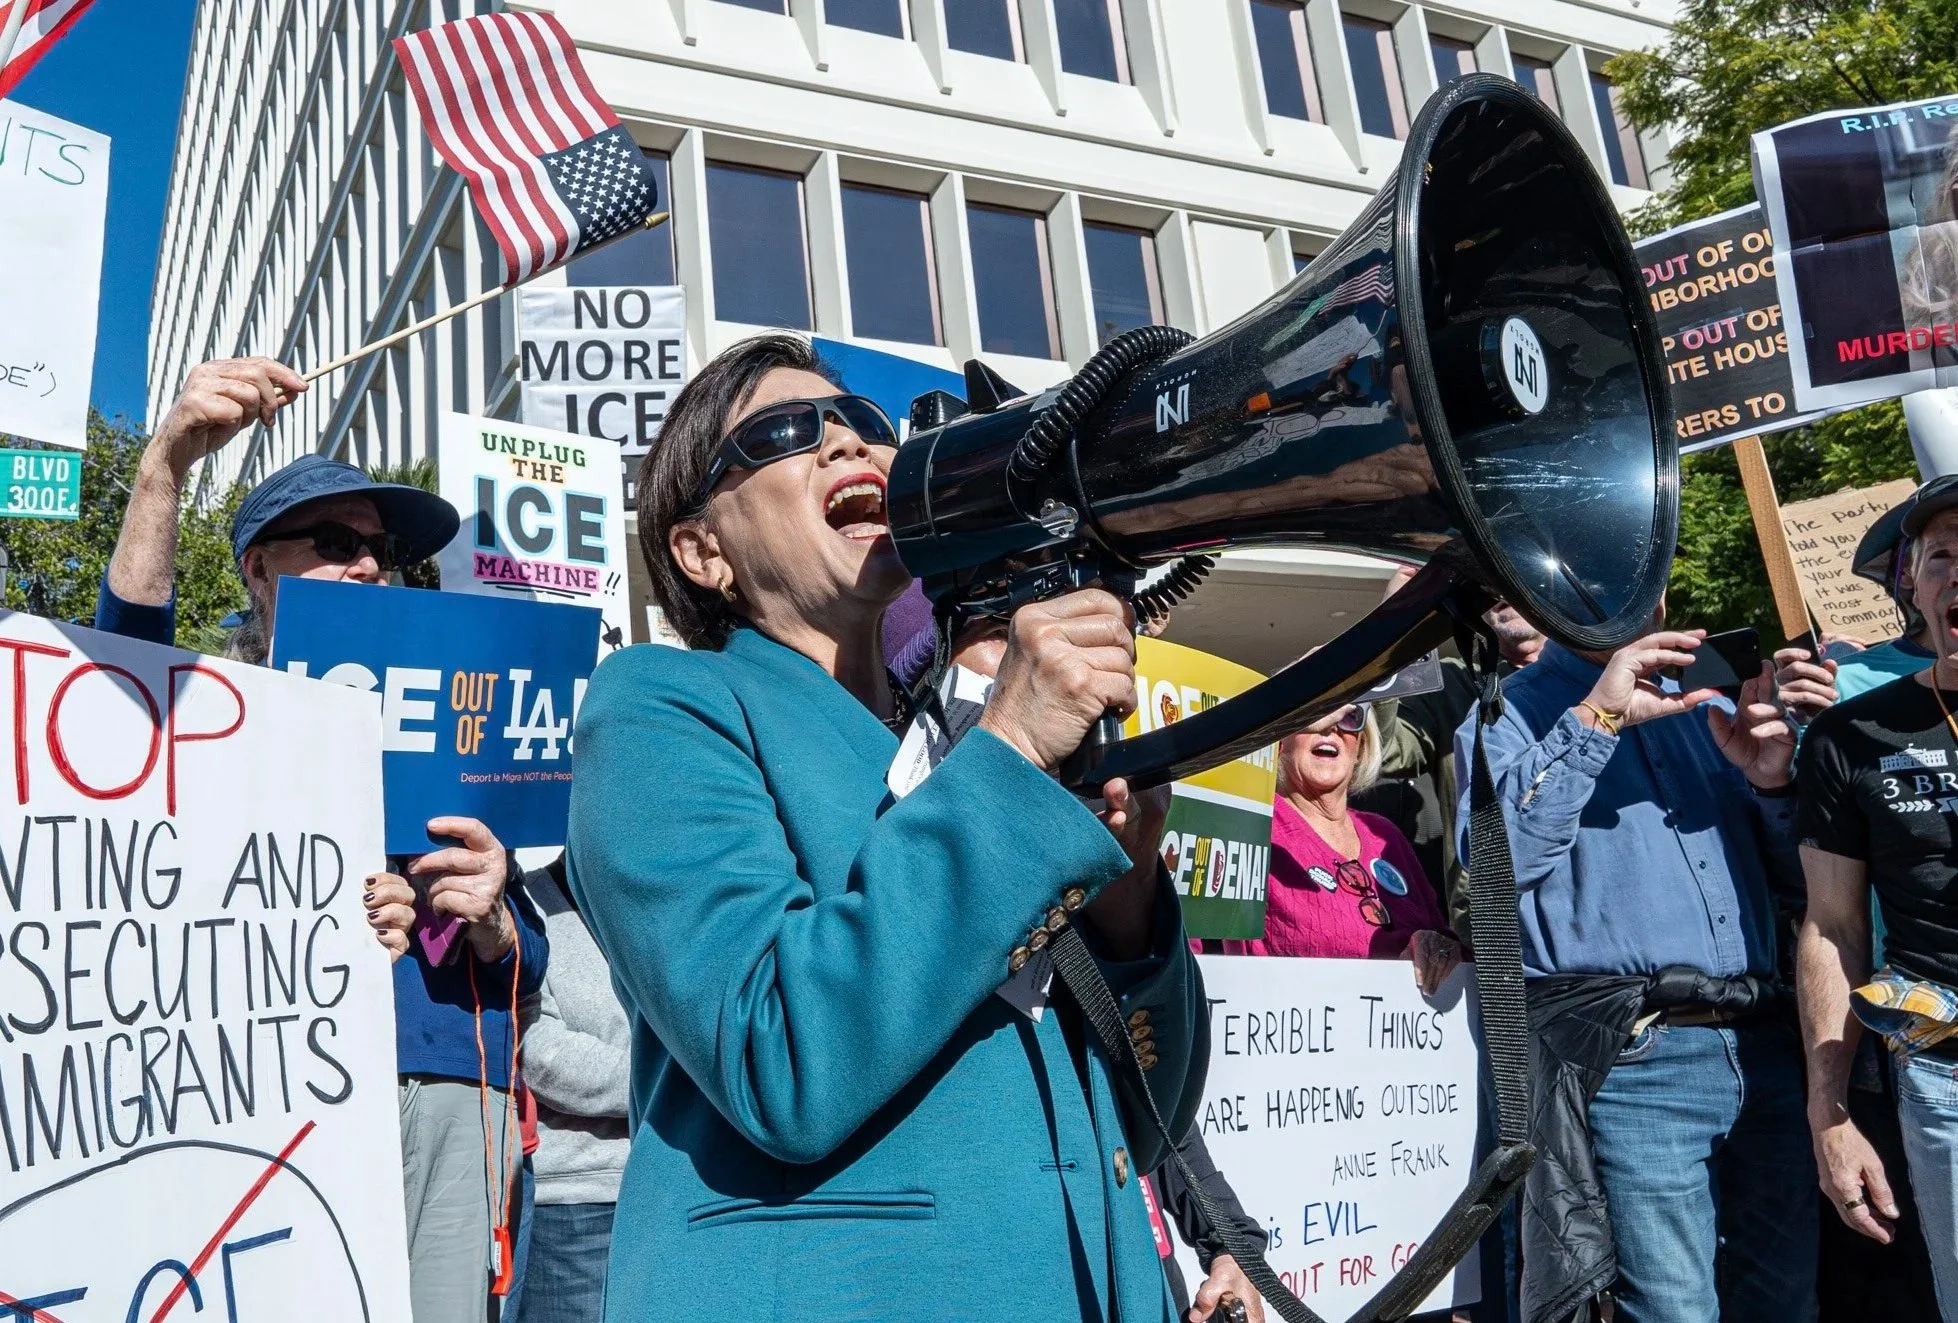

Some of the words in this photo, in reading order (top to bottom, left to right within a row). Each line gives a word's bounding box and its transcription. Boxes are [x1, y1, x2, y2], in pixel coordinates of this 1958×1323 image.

[1841, 110, 1914, 134] R.I.P.
[1697, 239, 1734, 268] OF
[573, 288, 651, 329] NO
[1682, 317, 1738, 350] OUT
[1746, 304, 1781, 331] OF
[1837, 321, 1958, 362] MURDE
[521, 340, 681, 382] MORE
[565, 391, 668, 447] ICE
[1744, 392, 1786, 419] TO
[13, 455, 69, 482] BLVD
[482, 432, 586, 467] UNPLUG
[512, 459, 564, 483] THE
[475, 476, 607, 565] ICE
[476, 555, 597, 589] MACHINE
[1805, 567, 1845, 586] your
[1822, 598, 1862, 611] most
[451, 670, 499, 712] OUT
[456, 714, 487, 755] OF
[460, 772, 491, 784] Deport
[502, 773, 522, 784] Migra
[524, 772, 539, 781] NOT
[1882, 777, 1901, 799] 3
[221, 831, 344, 911] AND
[1195, 837, 1212, 868] OUT
[1204, 838, 1269, 902] DENA!
[1192, 868, 1205, 898] OF
[1359, 995, 1444, 1051] THINGS
[1203, 1095, 1249, 1136] ARE
[1381, 1083, 1459, 1117] OUTSIDE
[1332, 1151, 1377, 1186] ANNE
[1390, 1140, 1450, 1176] FRANK
[1303, 1201, 1378, 1245] EVIL
[1340, 1255, 1377, 1286] FOR
